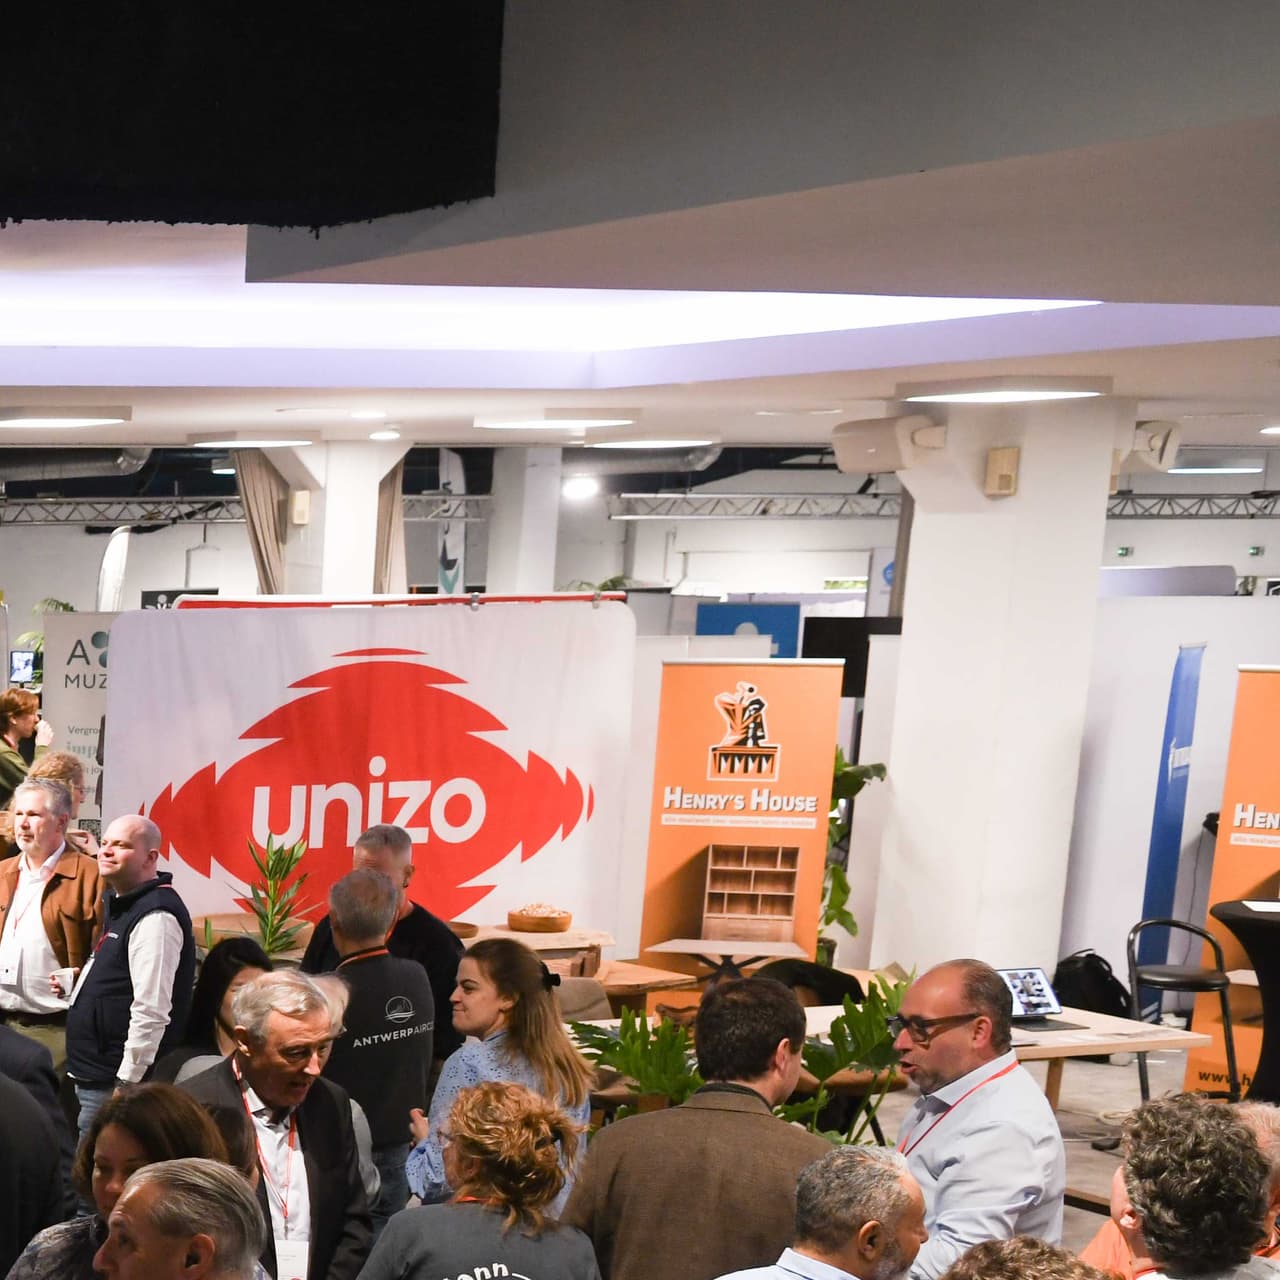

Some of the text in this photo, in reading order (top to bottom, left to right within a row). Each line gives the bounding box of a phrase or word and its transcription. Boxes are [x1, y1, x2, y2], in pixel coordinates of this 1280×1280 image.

[66, 639, 90, 666] A
[64, 674, 108, 689] MUZ
[251, 755, 487, 850] unizo
[1198, 1071, 1251, 1086] wwh
